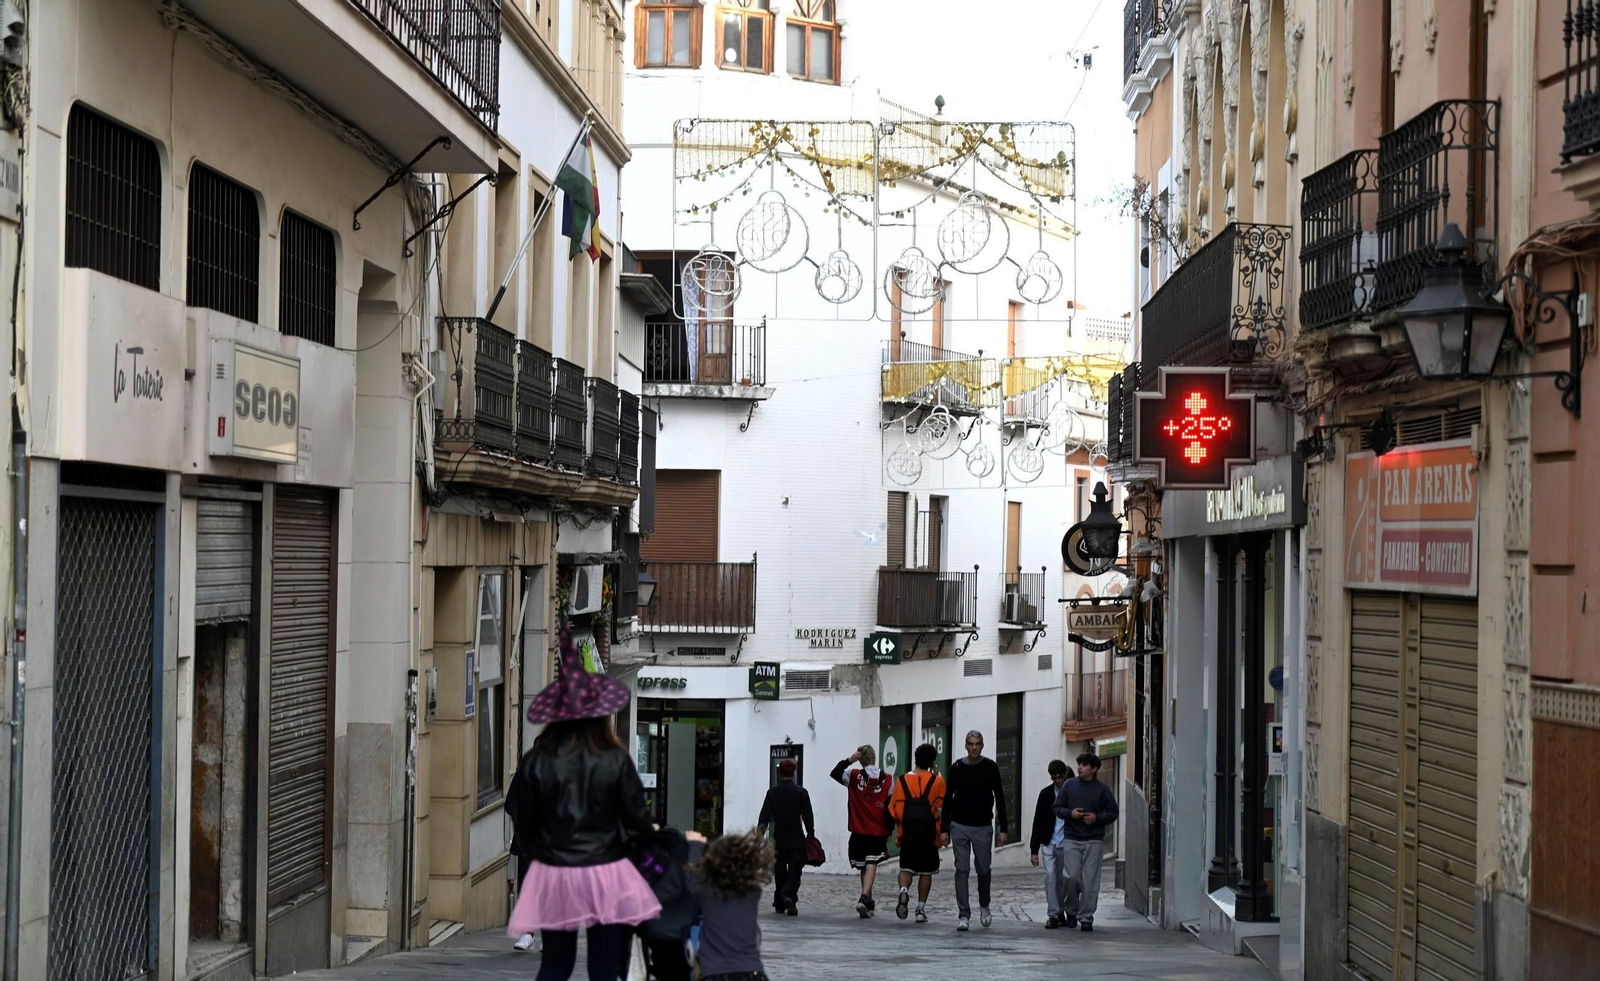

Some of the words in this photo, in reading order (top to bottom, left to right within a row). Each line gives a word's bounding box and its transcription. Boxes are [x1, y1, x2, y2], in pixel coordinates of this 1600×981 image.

[1384, 468, 1410, 506] PAN
[1414, 462, 1473, 505] ARENAS
[1383, 542, 1419, 572] PANADERIA
[1425, 542, 1470, 574] CONFITERIA
[796, 628, 857, 639] RODRIGUEZ
[810, 639, 844, 648] MARIN
[755, 665, 776, 677] ATM
